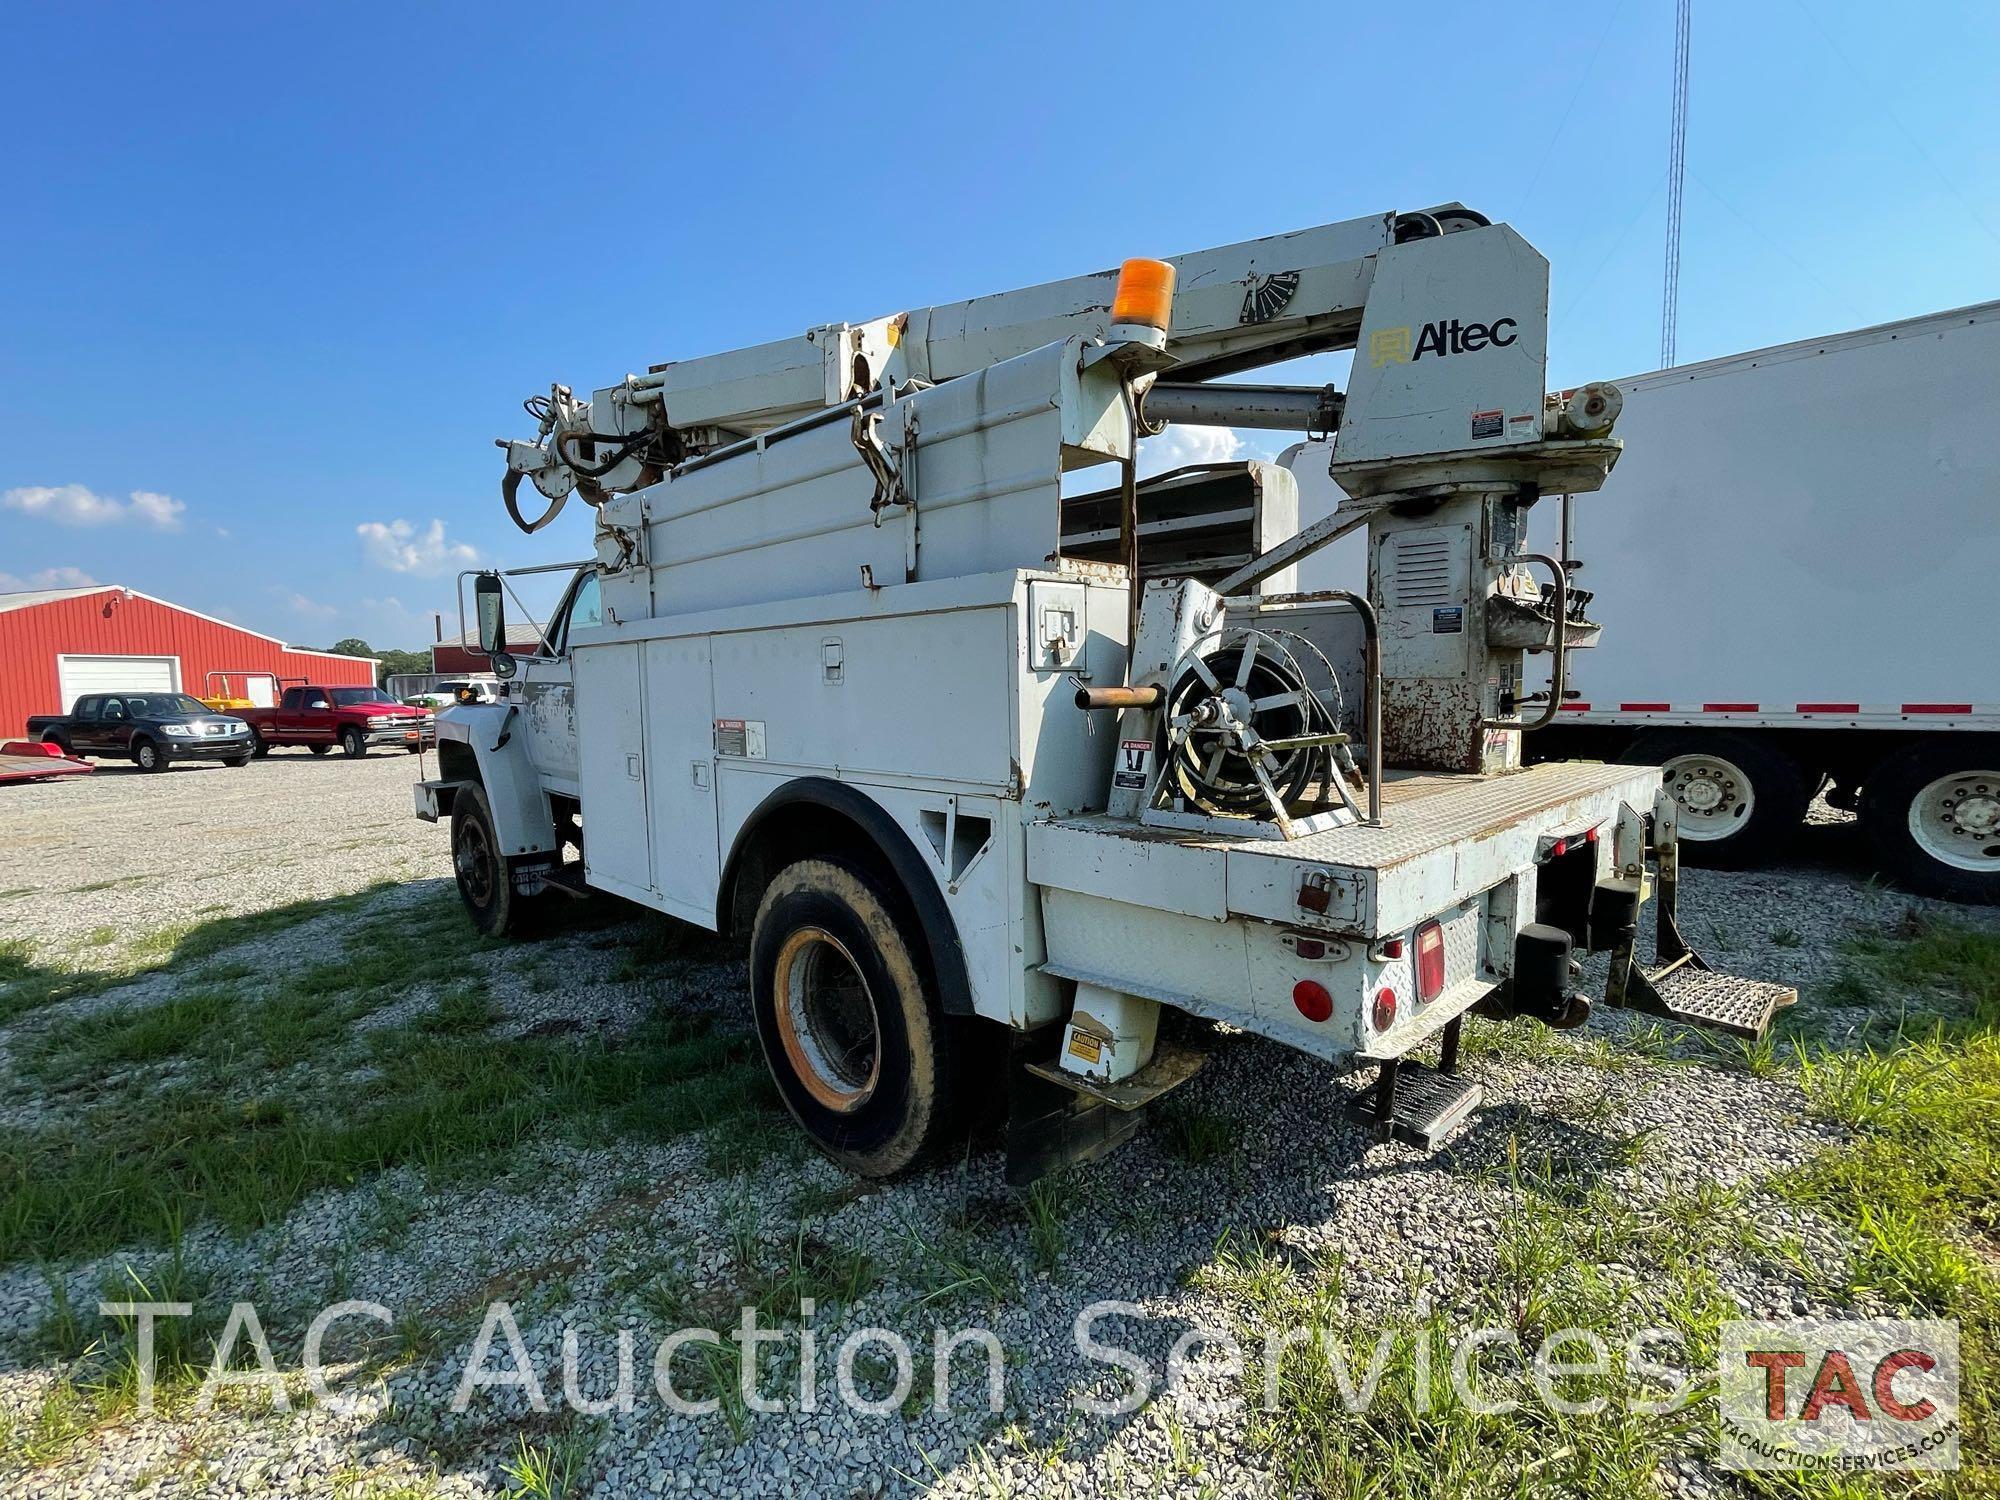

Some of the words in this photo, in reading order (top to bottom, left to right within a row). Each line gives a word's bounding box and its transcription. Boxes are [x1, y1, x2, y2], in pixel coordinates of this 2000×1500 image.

[1412, 317, 1518, 362] Altec
[1129, 742, 1151, 750] DANGER
[1073, 1032, 1100, 1049] CAUTION
